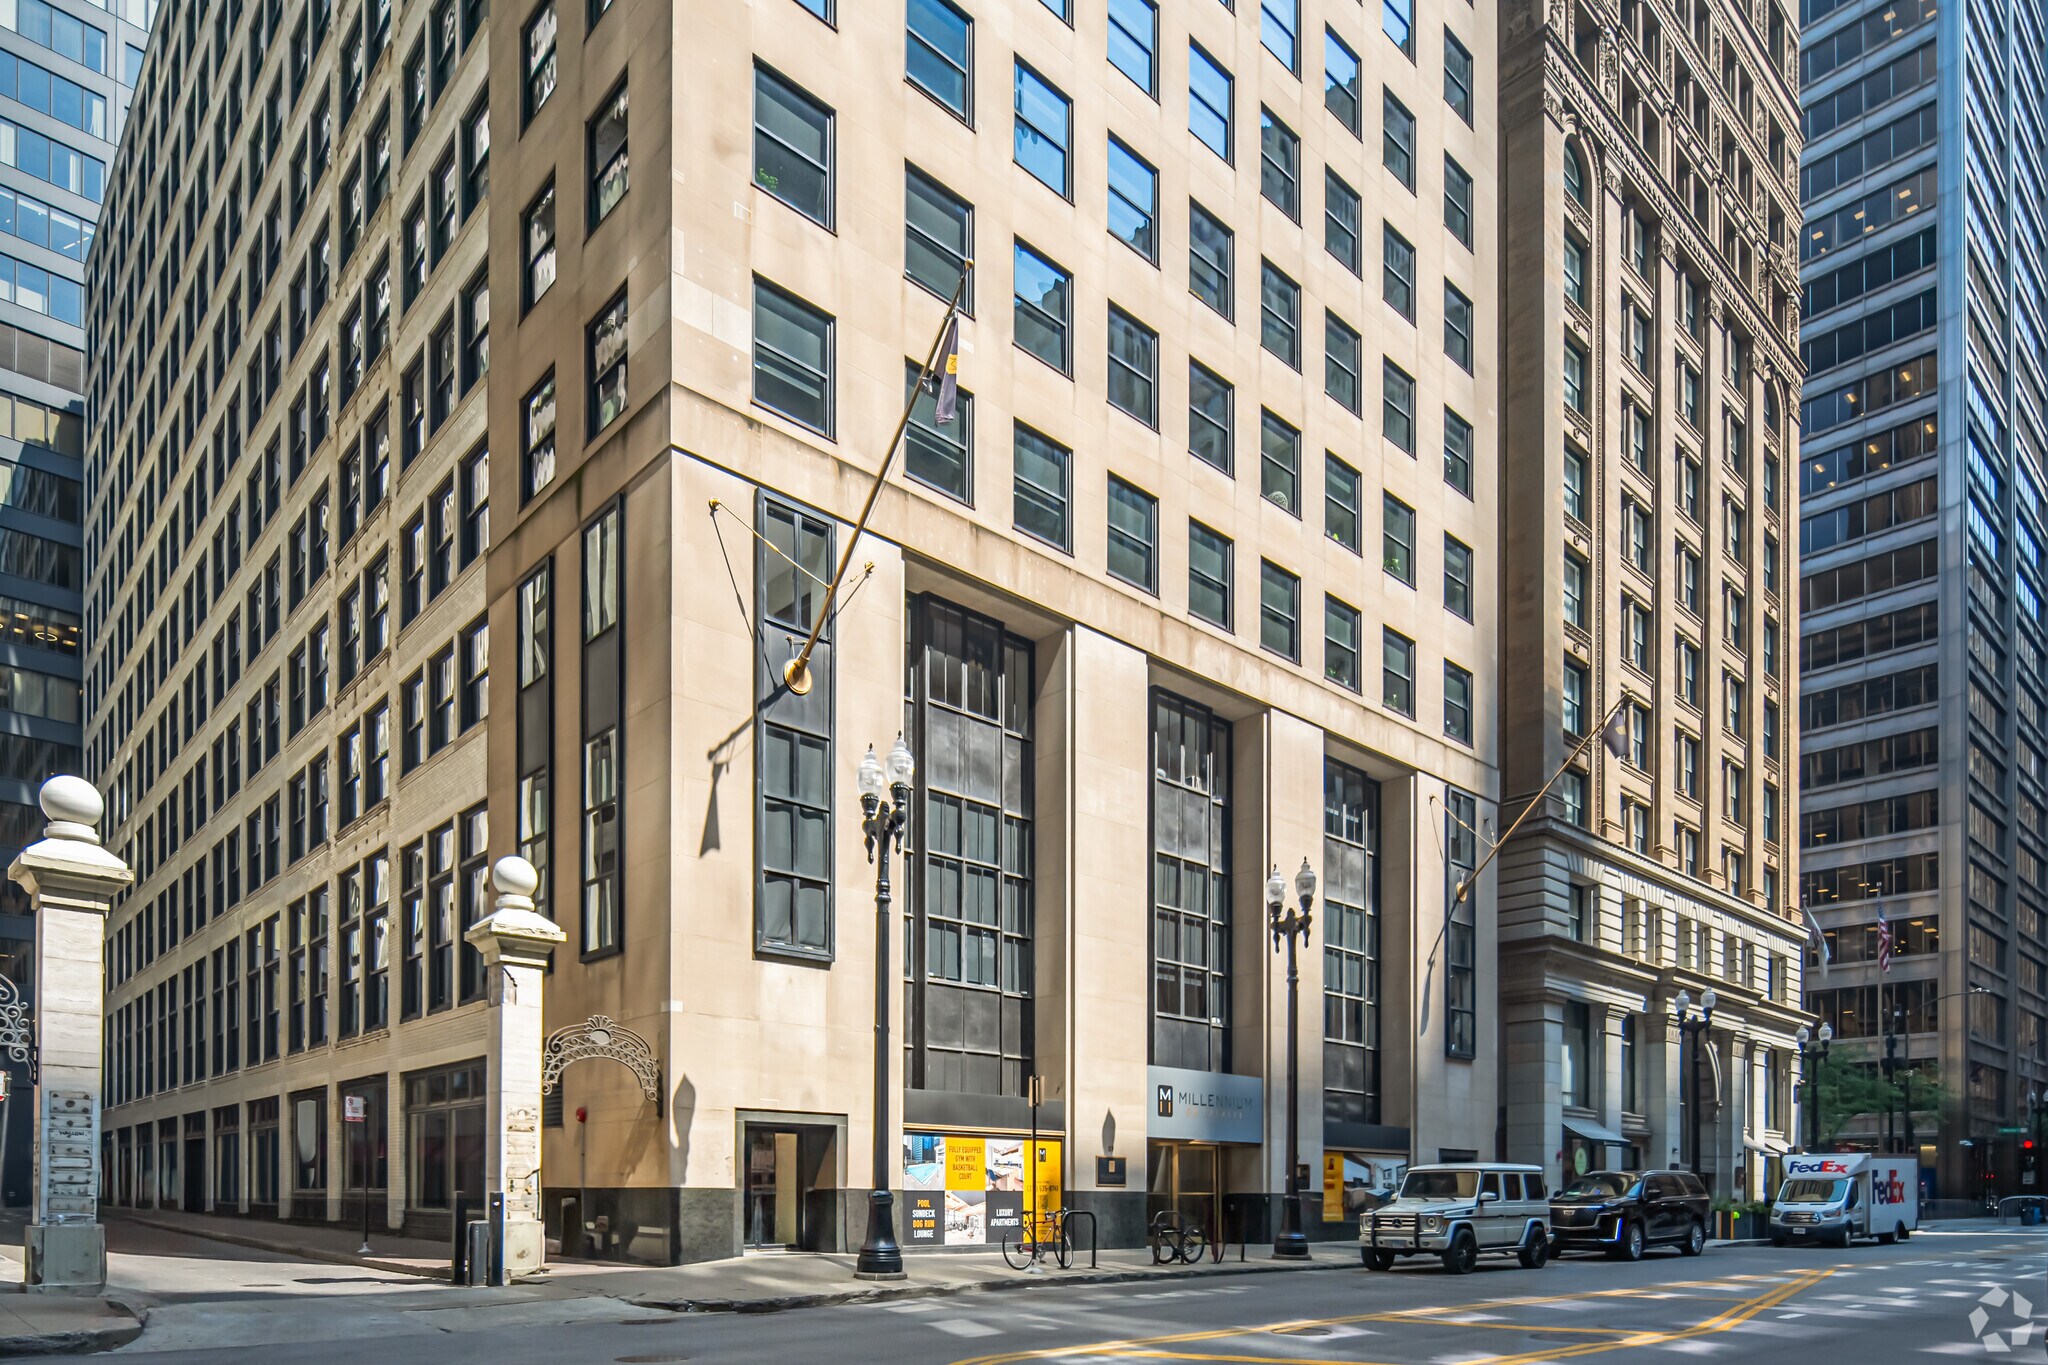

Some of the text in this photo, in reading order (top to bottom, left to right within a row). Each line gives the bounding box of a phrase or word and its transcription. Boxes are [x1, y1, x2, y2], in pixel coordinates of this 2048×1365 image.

[1179, 1092, 1253, 1110] MILLENNIUM
[962, 1146, 982, 1154] EQUIPPED
[1789, 1160, 1848, 1174] FedEx
[1872, 1169, 1905, 1205] FedEx
[917, 1199, 931, 1208] POOL
[912, 1209, 936, 1218] SUNDECK
[996, 1208, 1014, 1217] LUXURY
[912, 1219, 935, 1228] DOG RUN
[990, 1218, 1019, 1227] APARTMENTS
[913, 1229, 934, 1239] LOUNGE
